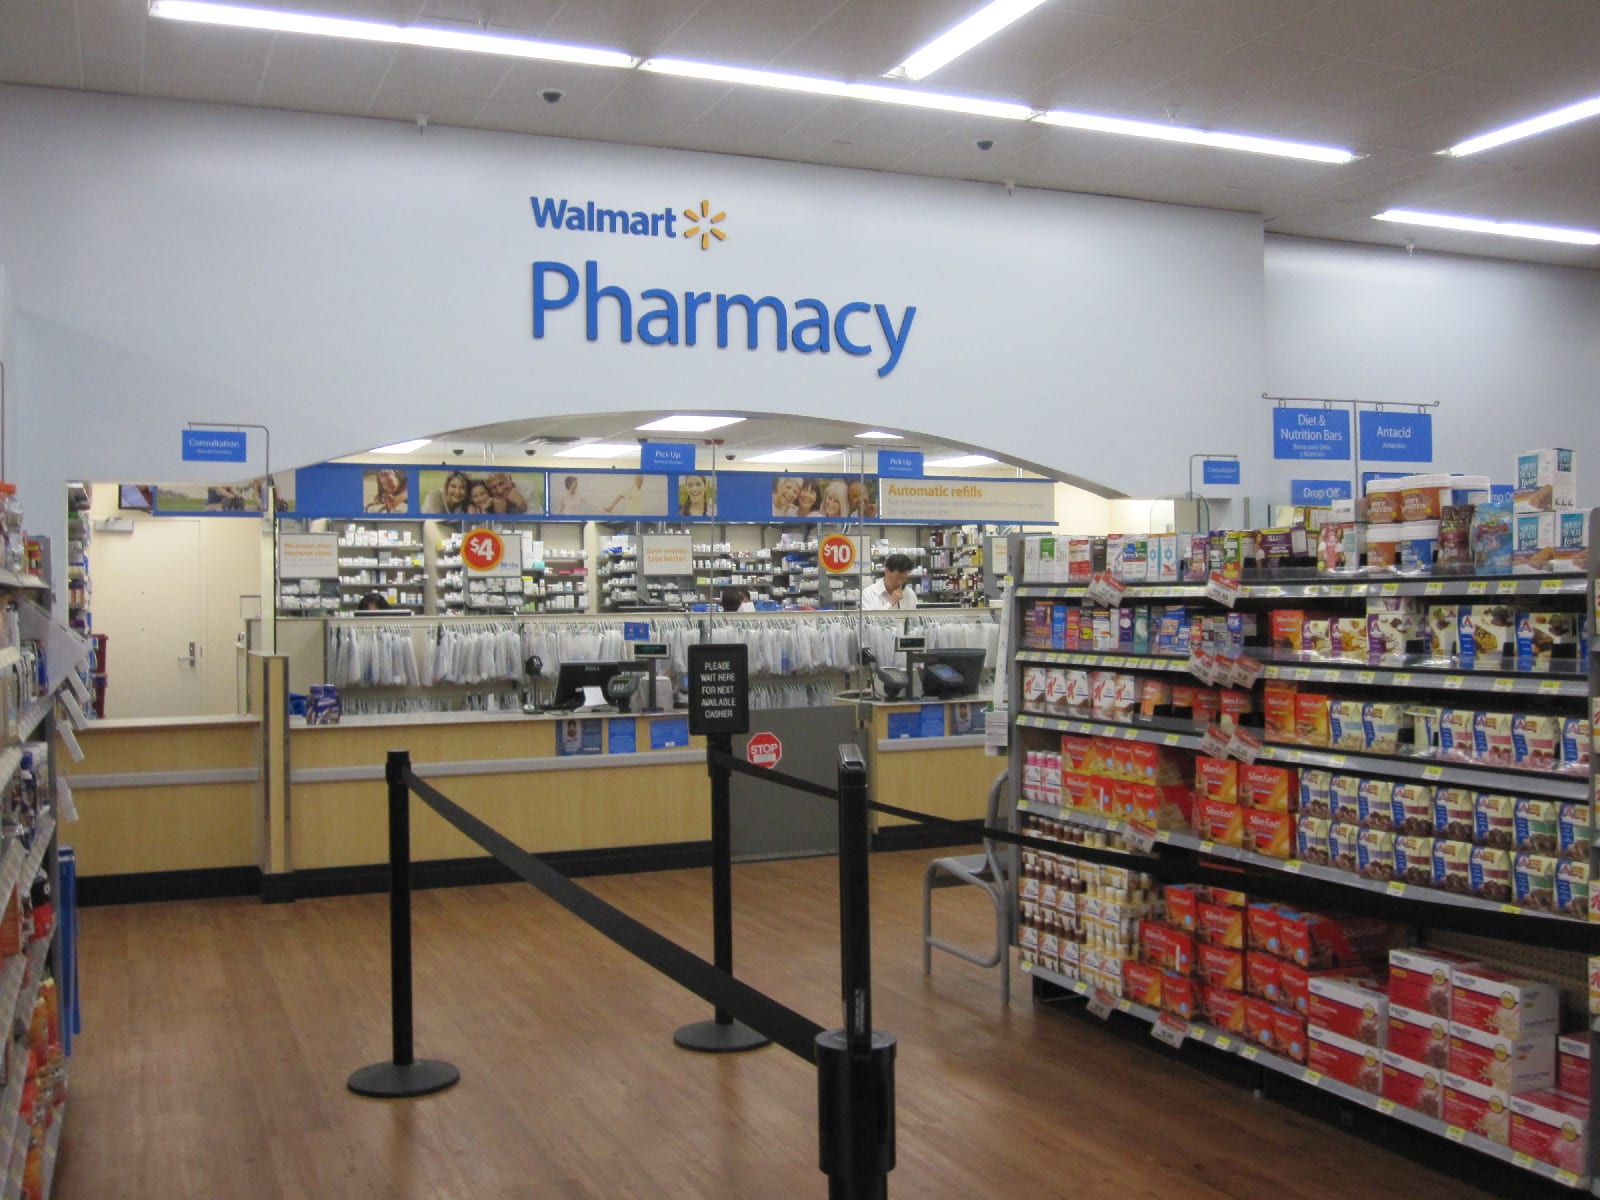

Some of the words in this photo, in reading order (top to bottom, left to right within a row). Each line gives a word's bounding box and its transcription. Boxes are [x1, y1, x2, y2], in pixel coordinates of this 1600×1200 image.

[530, 196, 677, 238] Walmart
[531, 260, 917, 378] Pharmacy
[1298, 414, 1317, 426] Diet
[1318, 415, 1327, 426] &
[1280, 428, 1324, 440] Nutrition
[1323, 430, 1343, 441] Bars
[1377, 426, 1412, 438] Antacid
[188, 438, 240, 449] Consultation
[655, 450, 670, 458] Pick
[670, 451, 681, 460] Up
[888, 483, 949, 497] Automatic
[951, 485, 983, 498] refills
[1303, 488, 1325, 500] Drop
[1326, 488, 1341, 499] Off
[470, 536, 495, 561] $4
[823, 543, 851, 564] $10
[704, 661, 731, 671] PLEASE
[700, 673, 716, 682] WAIT
[718, 673, 736, 682] HERE
[701, 686, 715, 695] FOR
[717, 685, 734, 695] NEXT
[701, 697, 736, 707] AVAILABLE
[704, 709, 733, 719] CASHIER
[750, 743, 778, 755] STOP
